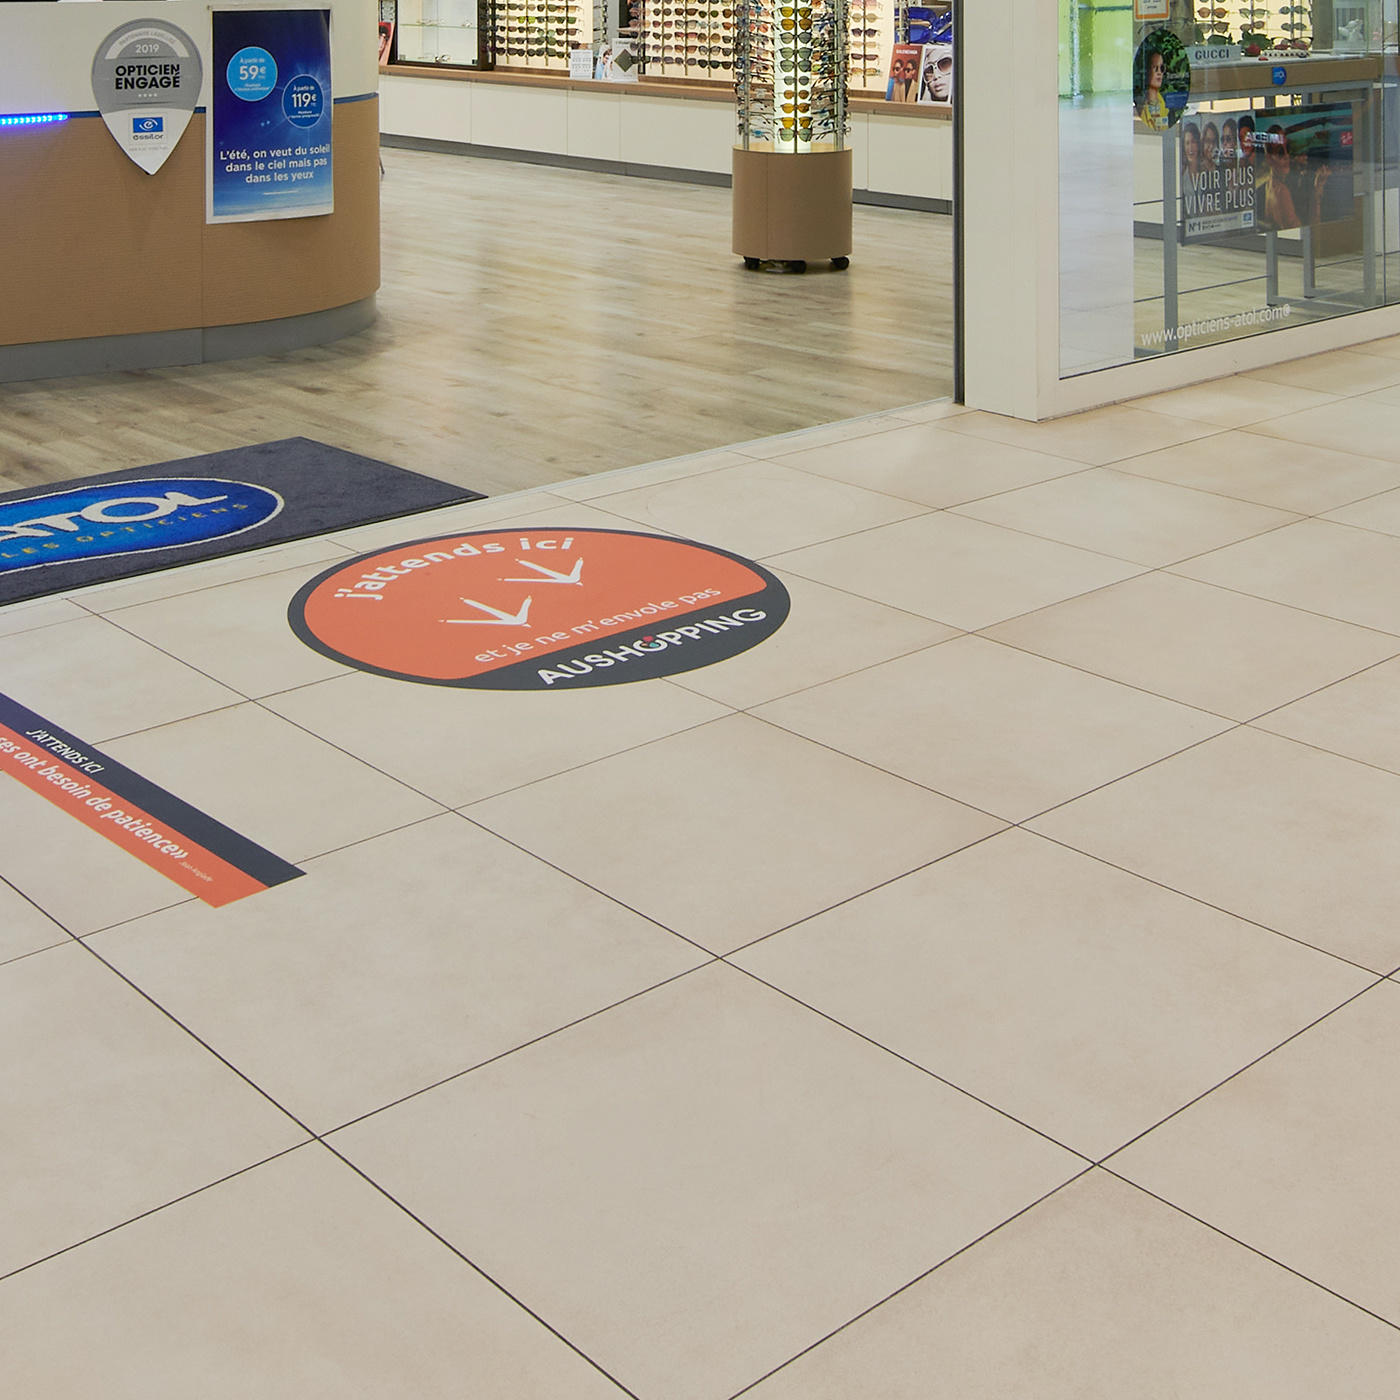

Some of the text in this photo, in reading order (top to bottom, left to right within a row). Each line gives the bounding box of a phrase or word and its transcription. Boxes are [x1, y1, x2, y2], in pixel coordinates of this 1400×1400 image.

[135, 44, 160, 54] 2019
[1195, 50, 1230, 60] GUCCI
[115, 63, 180, 76] OPTICIEN
[115, 72, 180, 89] ENGAGÉ
[253, 151, 267, 159] on
[269, 148, 292, 158] veut
[295, 145, 307, 155] du
[309, 144, 330, 154] soleil
[226, 157, 328, 172] dans le ciel mais pas
[245, 171, 314, 184] dans les yeux
[1192, 166, 1254, 191] VOIR PLUS
[1185, 188, 1254, 214] VIVRE PLUS
[1, 503, 249, 558] LES OPTICIENS
[334, 536, 574, 600] j'attends ici
[475, 587, 721, 664] et je ne m'envole pas
[537, 607, 767, 685] AUSHOPPING
[25, 729, 105, 774] J'ATTENDS ICI
[13, 751, 47, 770] ont
[37, 765, 91, 799] besoin
[85, 797, 113, 812] de
